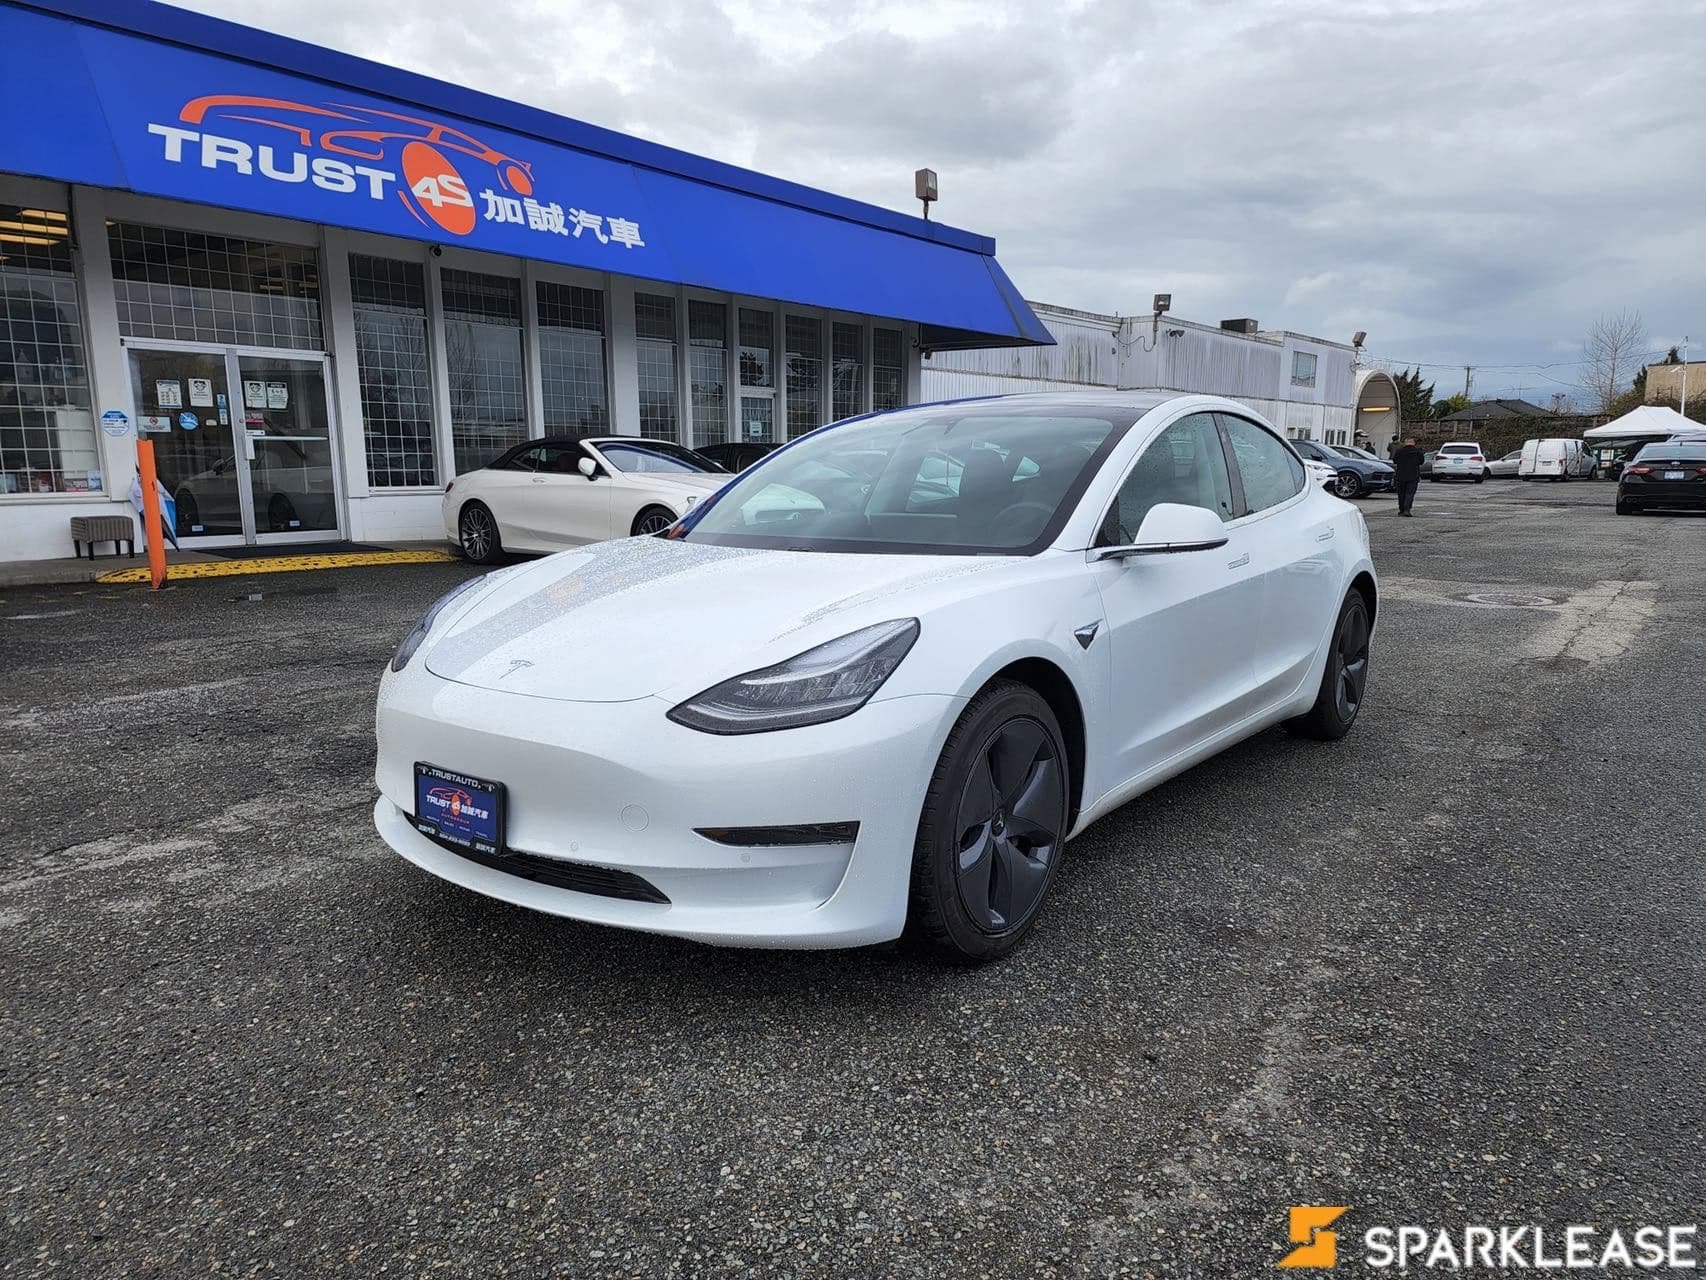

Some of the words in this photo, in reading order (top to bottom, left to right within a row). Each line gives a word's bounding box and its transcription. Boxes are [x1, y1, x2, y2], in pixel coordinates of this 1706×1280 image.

[147, 123, 396, 200] TRUST
[410, 174, 475, 208] 4S
[479, 188, 646, 249] 加誠汽車
[431, 769, 478, 787] TRUSTAUTO
[426, 794, 451, 809] TRUST
